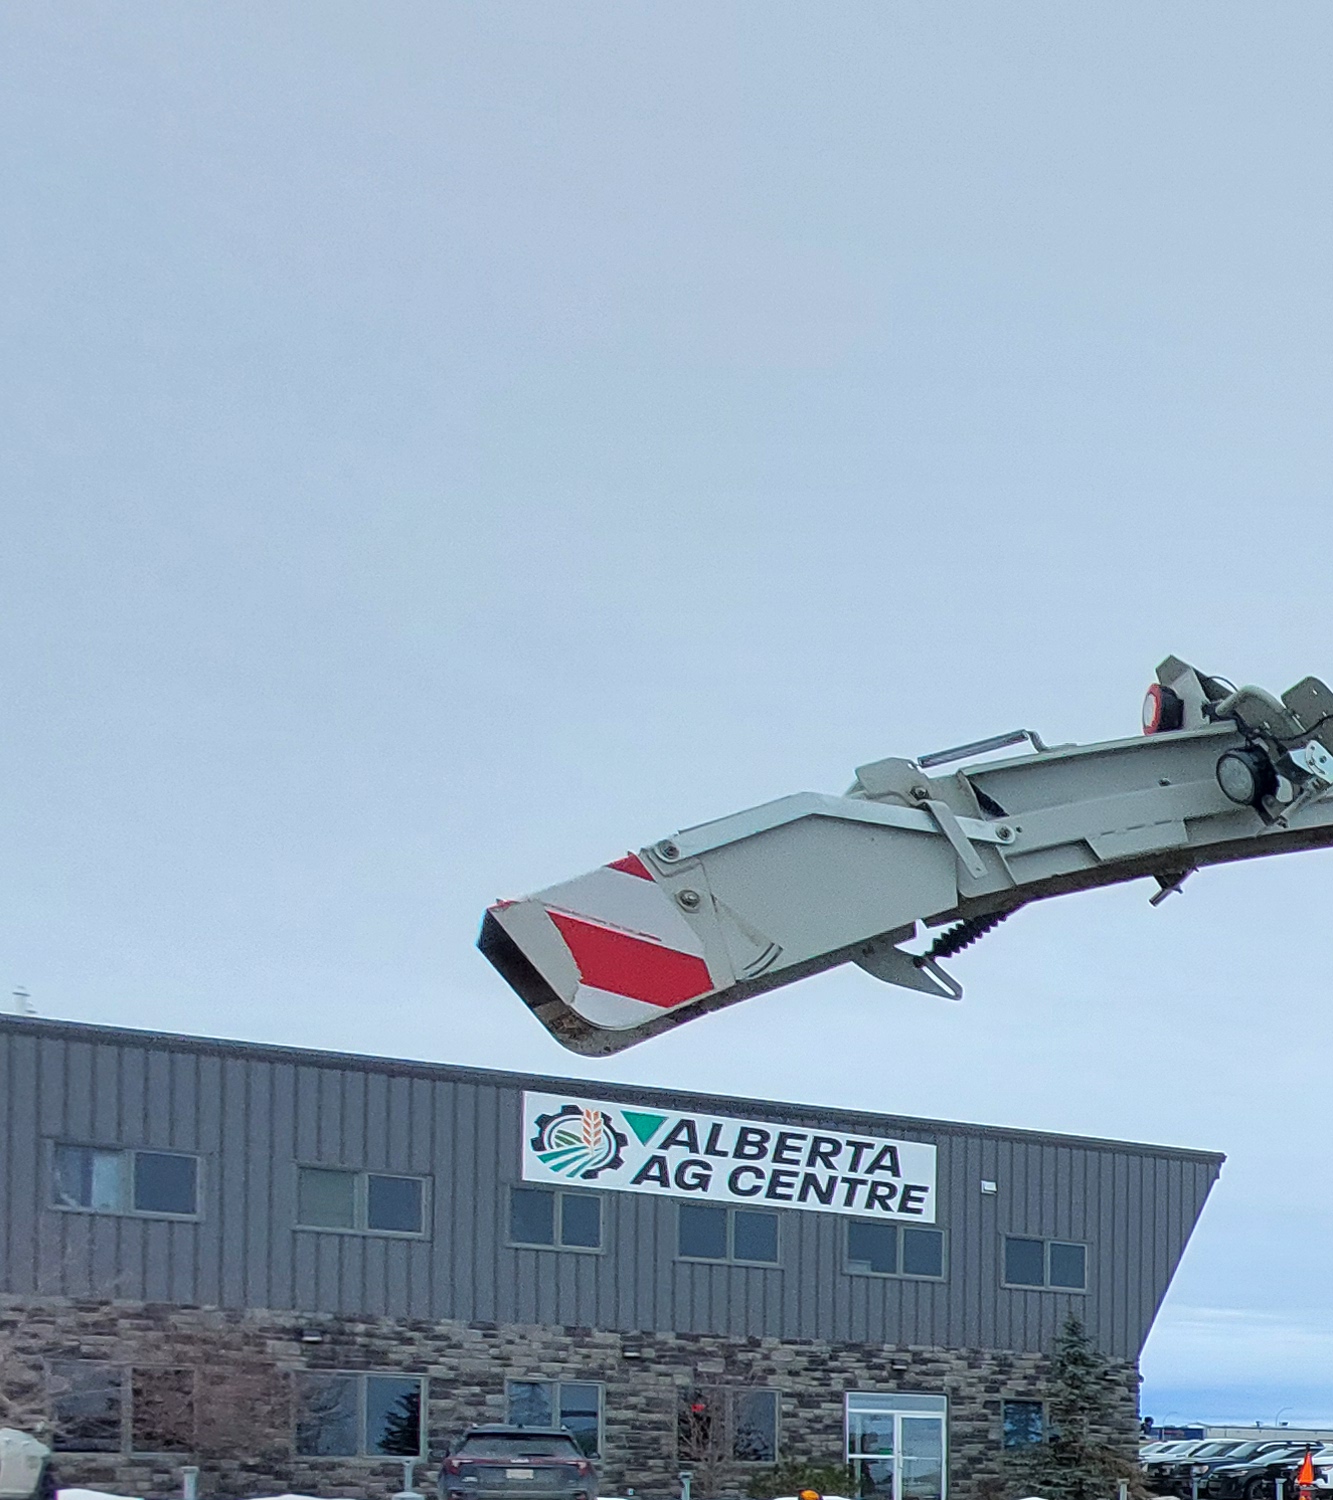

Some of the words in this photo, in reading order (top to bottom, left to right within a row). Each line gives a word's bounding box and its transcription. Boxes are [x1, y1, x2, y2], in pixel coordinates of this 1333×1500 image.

[658, 1117, 903, 1178] ALBERTA
[630, 1154, 714, 1193] AG
[726, 1165, 931, 1216] CENTRE
